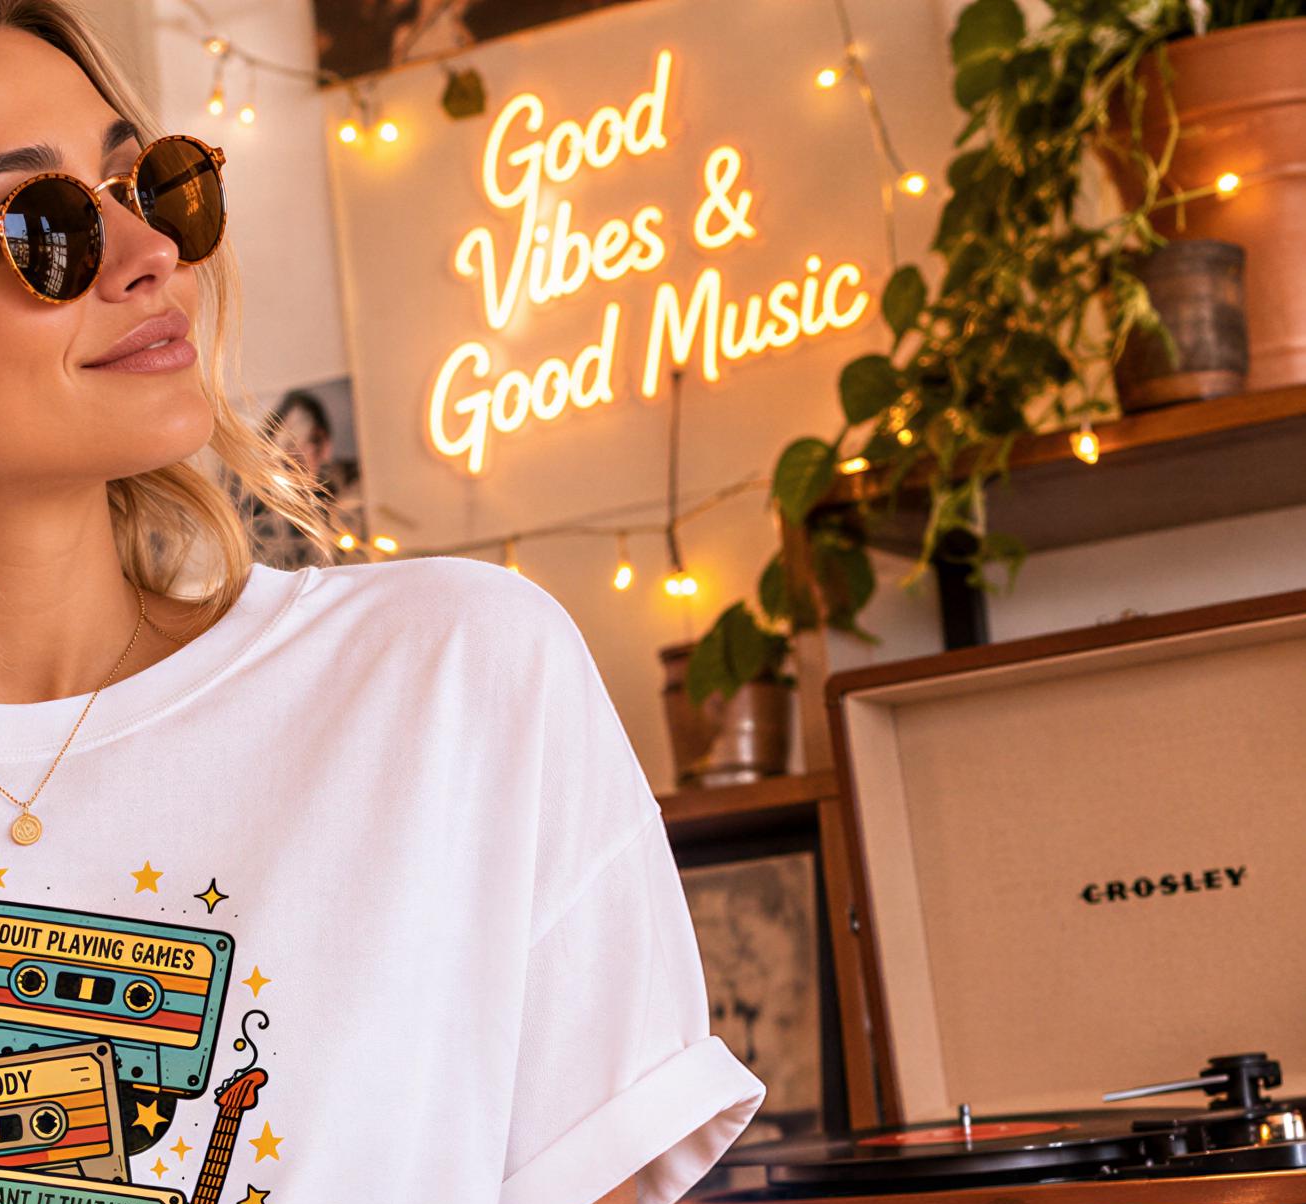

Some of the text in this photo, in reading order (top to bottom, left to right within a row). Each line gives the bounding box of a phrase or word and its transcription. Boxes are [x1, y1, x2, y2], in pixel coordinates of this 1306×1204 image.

[481, 48, 674, 210] Good
[453, 144, 758, 330] Vibes &
[428, 253, 871, 475] Good Music
[46, 930, 124, 961] PLAYING
[131, 942, 196, 971] GAMES
[1080, 864, 1248, 905] CROSLEY
